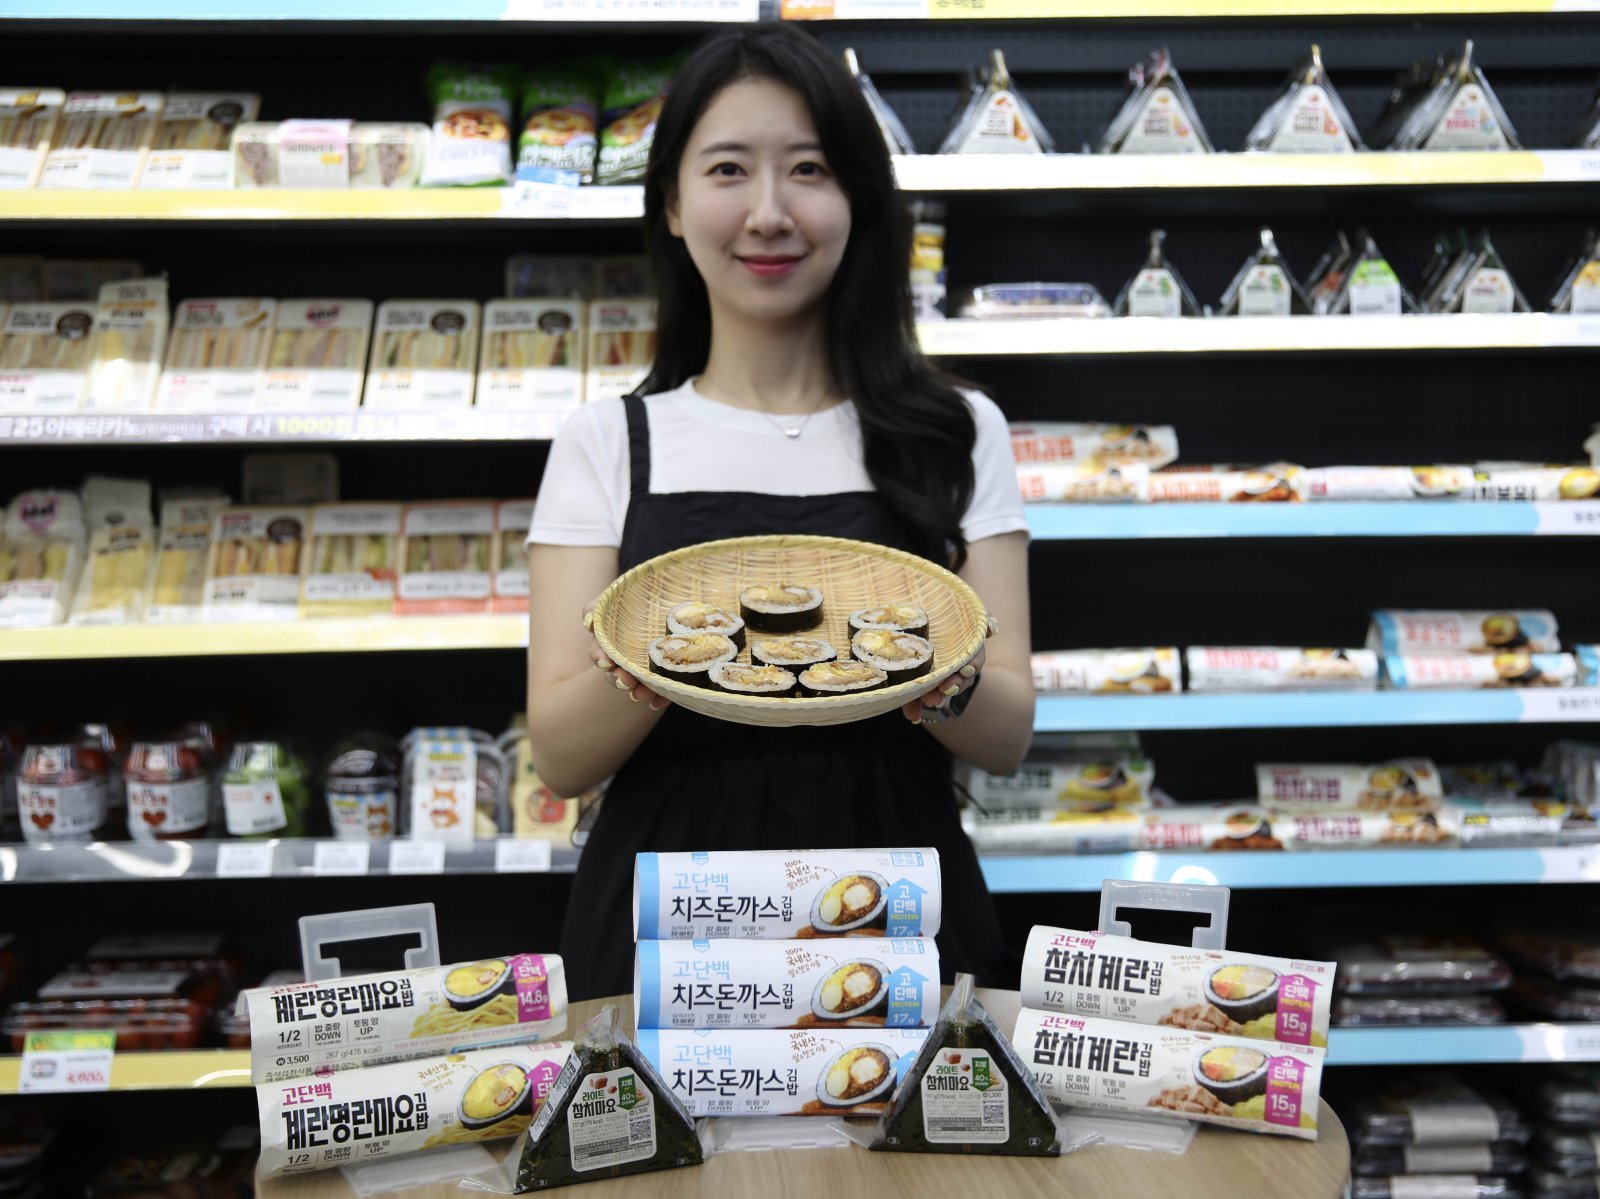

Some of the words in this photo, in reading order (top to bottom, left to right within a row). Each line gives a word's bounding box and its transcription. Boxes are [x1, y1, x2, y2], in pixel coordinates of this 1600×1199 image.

[785, 864, 811, 879] 국내산
[672, 872, 729, 893] 고단백
[671, 895, 780, 922] 치즈돈까스
[893, 899, 916, 914] 단백
[1050, 933, 1096, 950] 고단백
[786, 951, 812, 966] 국내산
[518, 966, 542, 977] 단백
[673, 960, 730, 980] 고단백
[1044, 947, 1150, 995] 참치계란
[1149, 961, 1164, 996] 김밥
[519, 989, 549, 1007] 14.8g
[672, 983, 781, 1010] 치즈돈까스
[894, 986, 917, 1001] 단백
[1043, 990, 1065, 1003] 1/2
[1284, 985, 1310, 1000] 단백
[270, 980, 401, 1024] 계란명란마요
[1076, 1001, 1101, 1011] DOWN
[1118, 1005, 1131, 1014] UP
[315, 1024, 323, 1033] 밥
[1039, 1015, 1086, 1031] 고단백
[1281, 1012, 1307, 1033] 15g
[279, 1029, 301, 1043] 1/2
[314, 1031, 341, 1042] DOWN
[359, 1026, 374, 1036] UP
[790, 1036, 817, 1051] 국내산
[673, 1045, 732, 1065] 고단백
[1033, 1029, 1139, 1076] 참치계란
[1138, 1042, 1153, 1078] 김밥
[541, 1066, 554, 1081] 고
[936, 1065, 959, 1075] 라이트
[1273, 1066, 1299, 1082] 단백
[672, 1068, 785, 1096] 치즈돈까스
[926, 1074, 970, 1091] 참치마요
[1065, 1082, 1090, 1092] DOWN
[282, 1082, 333, 1106] 고단백
[582, 1090, 606, 1102] 라이트
[572, 1098, 617, 1119] 참치마요
[1271, 1094, 1297, 1114] 15g
[281, 1094, 415, 1150] 계란명란마요
[414, 1092, 429, 1131] 김밥
[323, 1151, 351, 1161] DOWN
[369, 1146, 384, 1154] UP
[287, 1153, 310, 1164] 1/2
